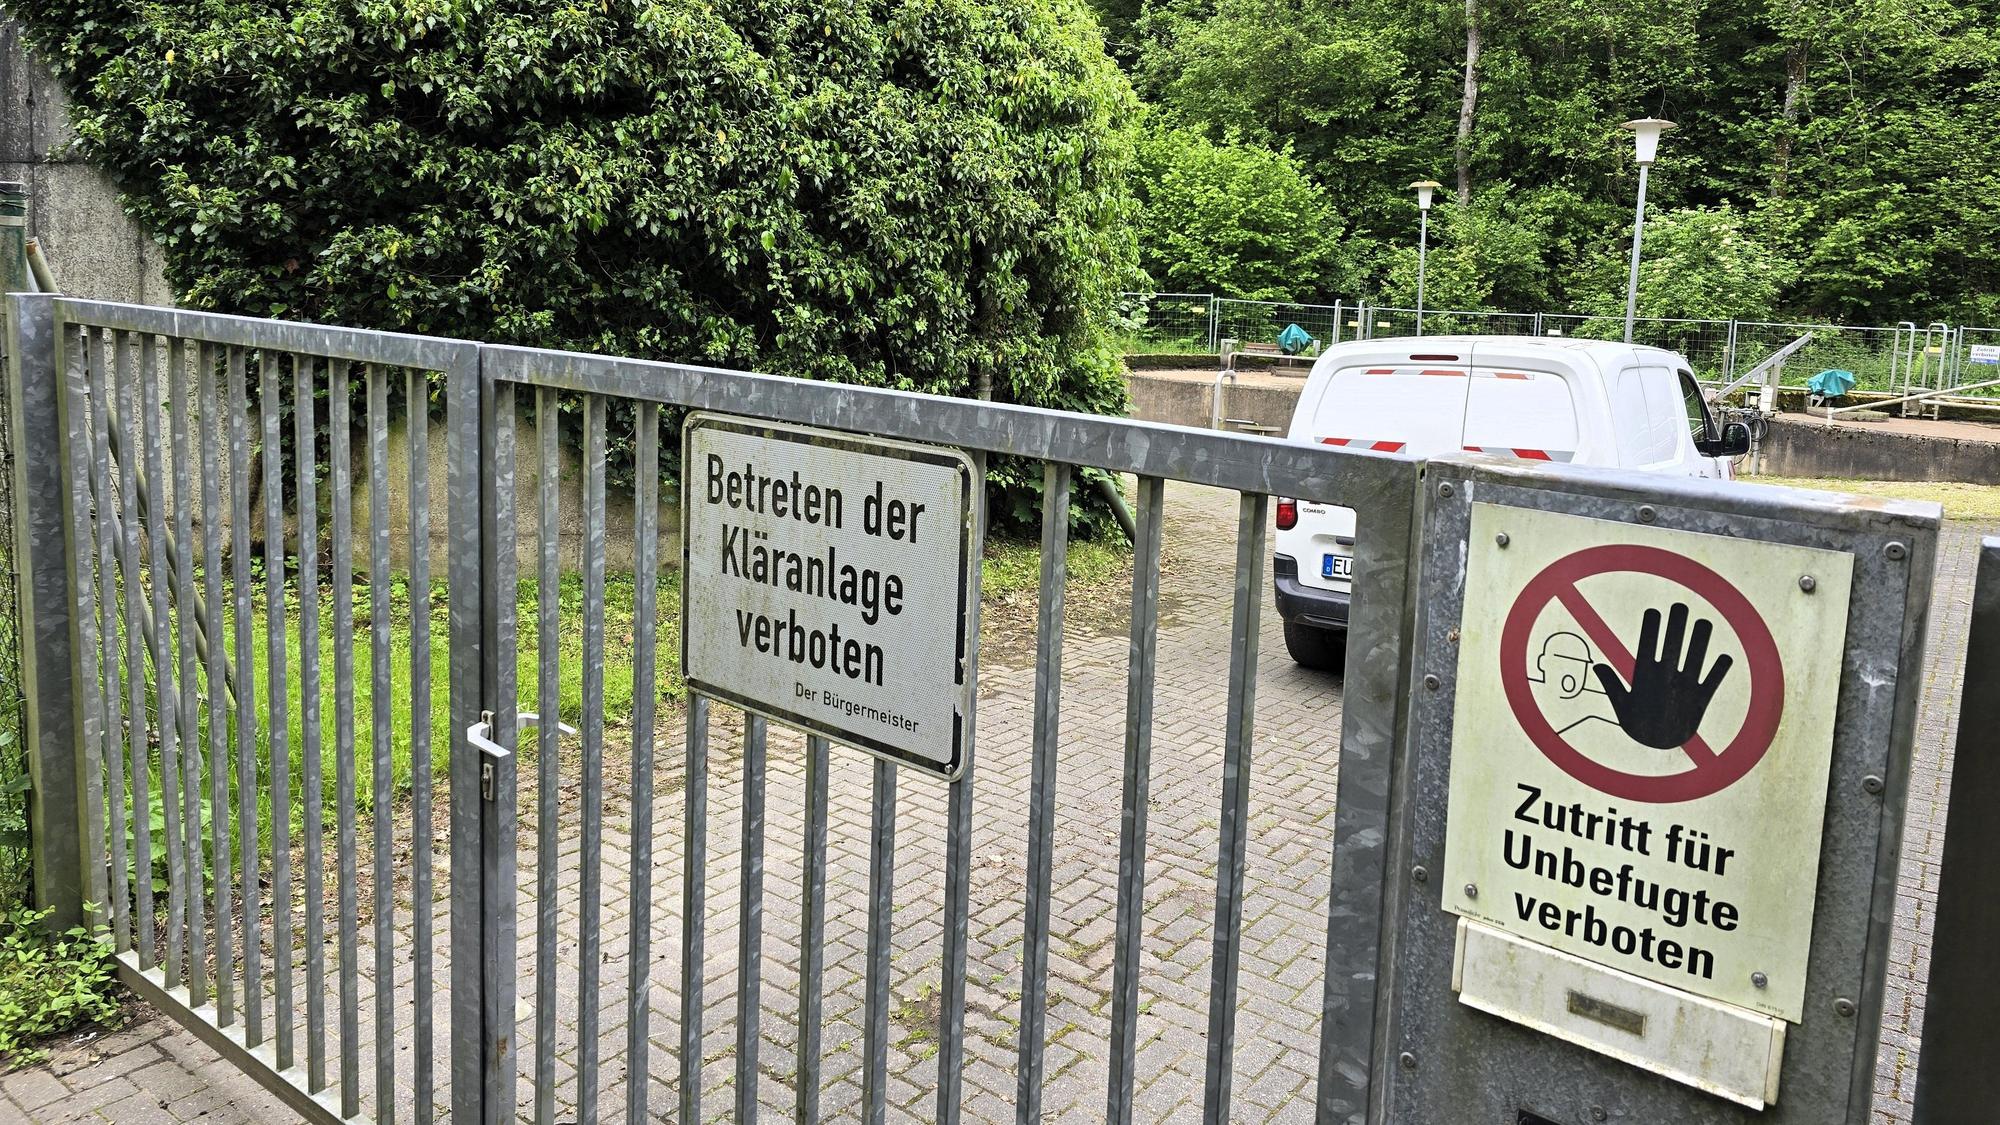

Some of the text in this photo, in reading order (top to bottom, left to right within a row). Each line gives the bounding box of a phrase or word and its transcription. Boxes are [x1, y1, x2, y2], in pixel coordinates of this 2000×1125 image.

[707, 453, 925, 543] Betreten der
[1302, 507, 1326, 515] COMBO
[721, 523, 904, 626] Kläranlage
[1333, 558, 1354, 576] EU
[736, 608, 883, 686] verboten
[795, 682, 919, 733] Der Bürgermeister
[1514, 782, 1735, 876] Zutritt für
[1503, 829, 1739, 931] Unbefugte
[1514, 891, 1715, 980] verboten
